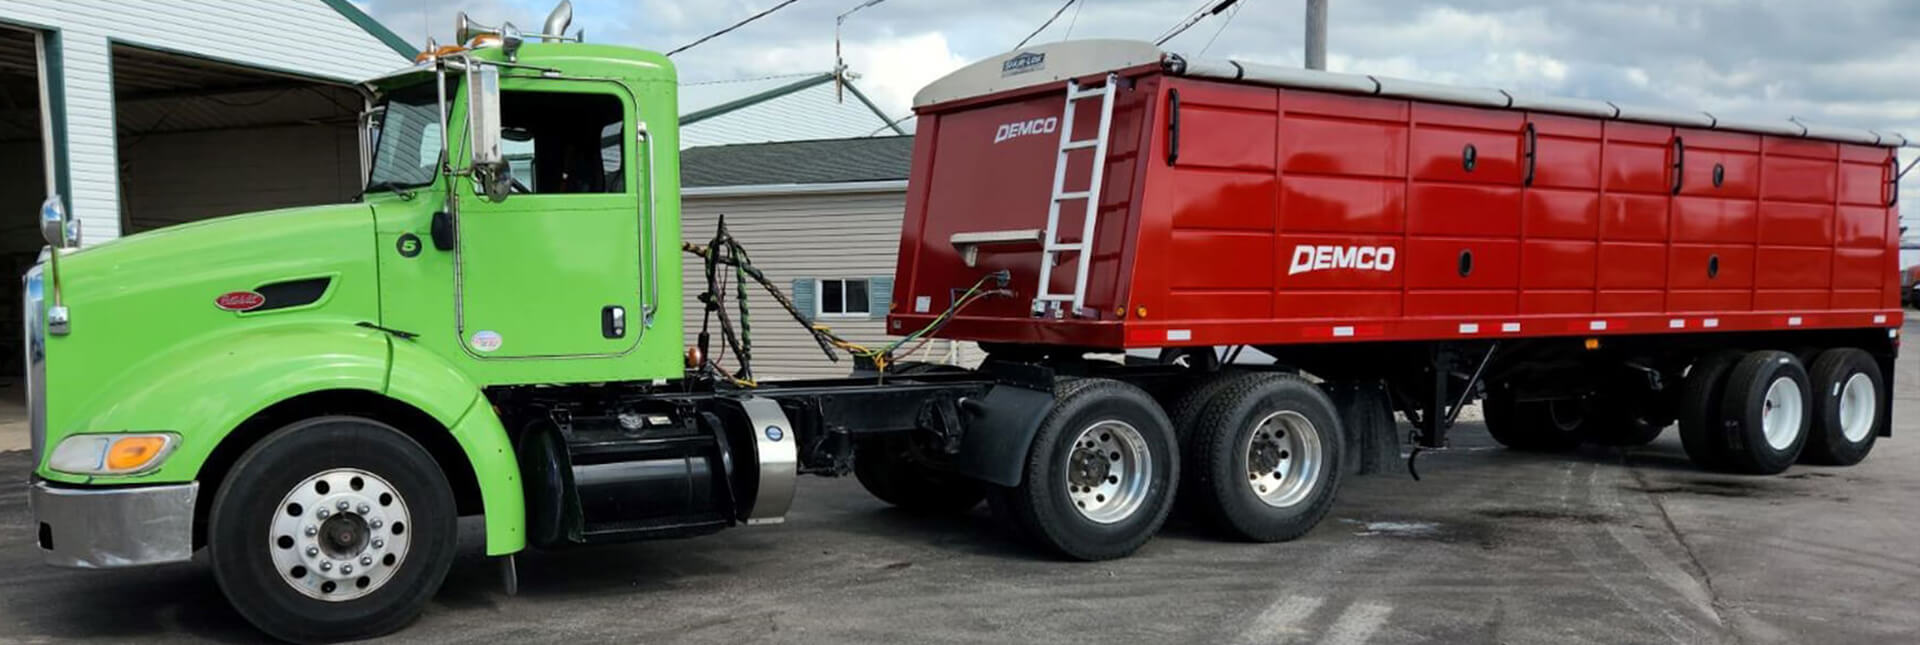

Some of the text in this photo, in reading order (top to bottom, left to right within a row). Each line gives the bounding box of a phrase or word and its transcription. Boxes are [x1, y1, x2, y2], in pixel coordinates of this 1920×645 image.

[993, 117, 1057, 144] DEMCO
[402, 240, 416, 251] 5
[1288, 245, 1396, 275] DEMCO
